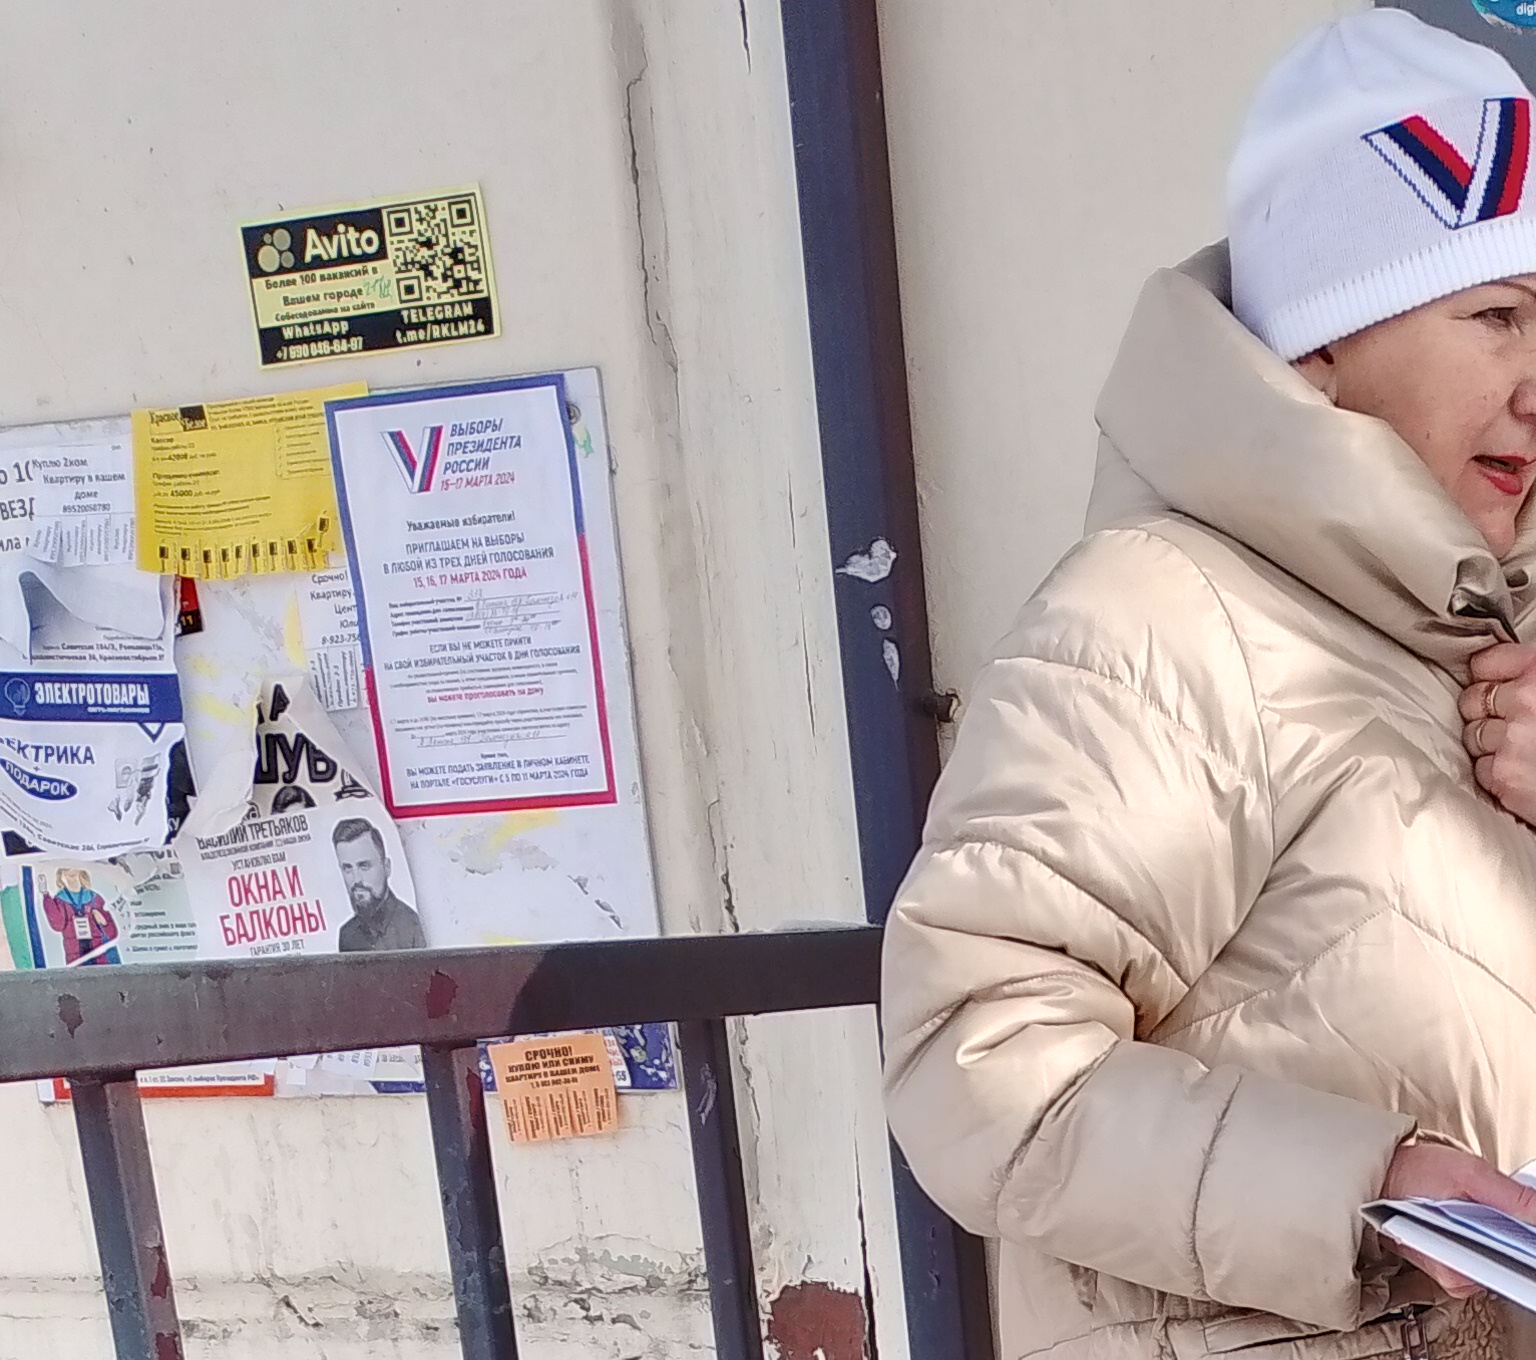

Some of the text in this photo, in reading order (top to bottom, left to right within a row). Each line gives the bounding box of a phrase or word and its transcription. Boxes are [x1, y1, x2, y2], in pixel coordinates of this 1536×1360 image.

[304, 222, 380, 263] Avito
[265, 277, 297, 289] Более
[299, 272, 317, 284] 100
[319, 265, 369, 282] вакансий
[283, 288, 363, 306] Вашем городе
[400, 302, 474, 325] TELEGRAM
[282, 321, 350, 341] WhatsApp
[450, 418, 504, 437] ВЫБОРЫ
[447, 435, 522, 457] ПРЕЗИДЕНТА
[32, 457, 89, 470] Куплю 2ком
[443, 457, 490, 475] РОССИИ
[43, 474, 86, 486] Квартиру
[464, 473, 493, 489] МАРТА
[494, 472, 516, 485] 2024
[74, 491, 99, 501] доме
[406, 510, 516, 532] Уважаемые избиратели!
[406, 532, 525, 555] ПРИГЛАШАЕМ НА ВЫБОРЫ
[383, 547, 554, 574] В ЛЮБОЙ ИЗ ТРЕХ ДНЕЙ ГОЛОСОВАНИЯ
[312, 569, 348, 585] Срочно!
[413, 577, 426, 589] 15,
[439, 574, 449, 585] 17
[451, 571, 480, 584] МАРТА
[482, 569, 501, 581] 2024
[503, 566, 528, 580] ГОДА
[429, 643, 448, 653] ЕСЛИ
[449, 642, 460, 652] ВЫ
[462, 641, 472, 651] НЕ
[473, 638, 503, 650] МОЖЕТЕ
[384, 662, 393, 671] НА
[394, 658, 412, 670] СВОЙ
[414, 654, 474, 668] ИЗБИРАТЕЛЬНЫЙ
[476, 652, 506, 663] УЧАСТОК
[514, 650, 529, 660] ДНИ
[530, 645, 581, 659] ГОЛОСОВАНИЯ
[35, 682, 150, 706] ЭЛЕКТРОТОВАРЫ
[0, 737, 95, 764] ЕКТРИКА
[5, 763, 70, 796] ПОДАРОК
[406, 767, 417, 777] ВЫ
[418, 764, 446, 776] МОЖЕТЕ
[448, 763, 474, 774] ПОДАТЬ
[410, 780, 419, 789] НА
[530, 770, 552, 780] МАРТА
[554, 769, 569, 779] 2024
[570, 767, 589, 778] ГОДА
[248, 815, 309, 842] ТРЕТЬЯКОВ
[228, 865, 304, 908] ОКНА И
[219, 899, 327, 947] БАЛКОНЫ
[249, 941, 281, 957] ГАРАНТИЯ
[291, 938, 305, 951] ЛЕТ
[508, 1055, 594, 1073] КУПЛЮ ИЛИ СНИМУ
[524, 1045, 573, 1062] СРОЧНО!
[505, 1072, 542, 1083] КВАРТИРУ
[550, 1068, 578, 1078] ВАШЕМ
[579, 1065, 601, 1076] ДОМЕ
